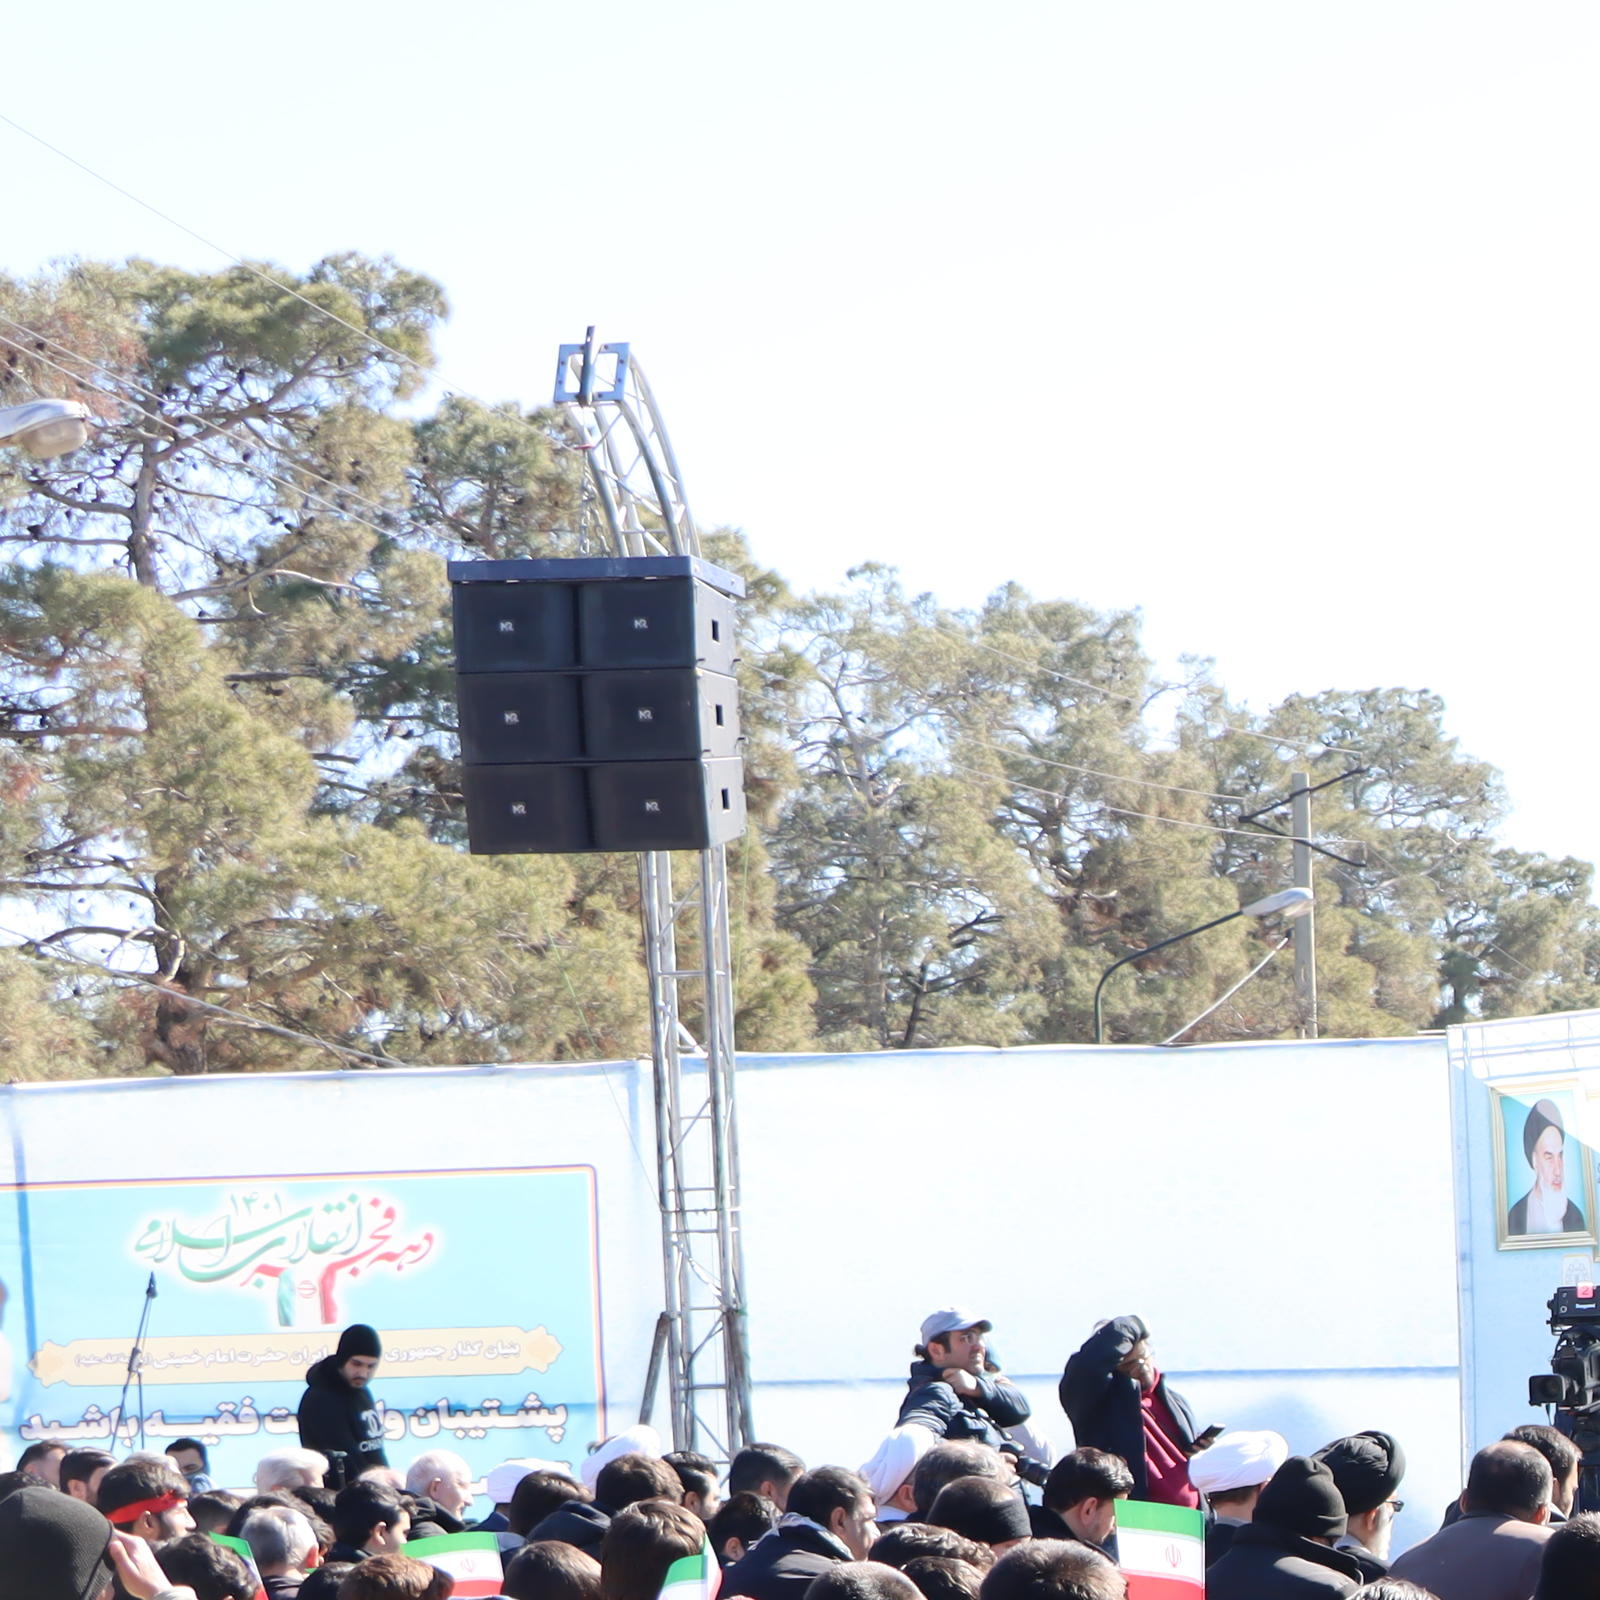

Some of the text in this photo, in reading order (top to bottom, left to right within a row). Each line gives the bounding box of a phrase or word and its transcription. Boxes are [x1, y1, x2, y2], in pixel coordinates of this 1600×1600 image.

[132, 1204, 314, 1267] اسلامی
[178, 1191, 364, 1290] انقلاب
[372, 1229, 436, 1273] دهه
[153, 1350, 203, 1370] خمینی
[204, 1348, 236, 1368] امام
[237, 1349, 288, 1368] حضرت
[290, 1344, 329, 1366] ایران
[384, 1344, 447, 1362] جمهوری
[483, 1340, 522, 1358] بنیان
[142, 1395, 261, 1447] فقیه
[409, 1392, 568, 1443] پشتیبان
